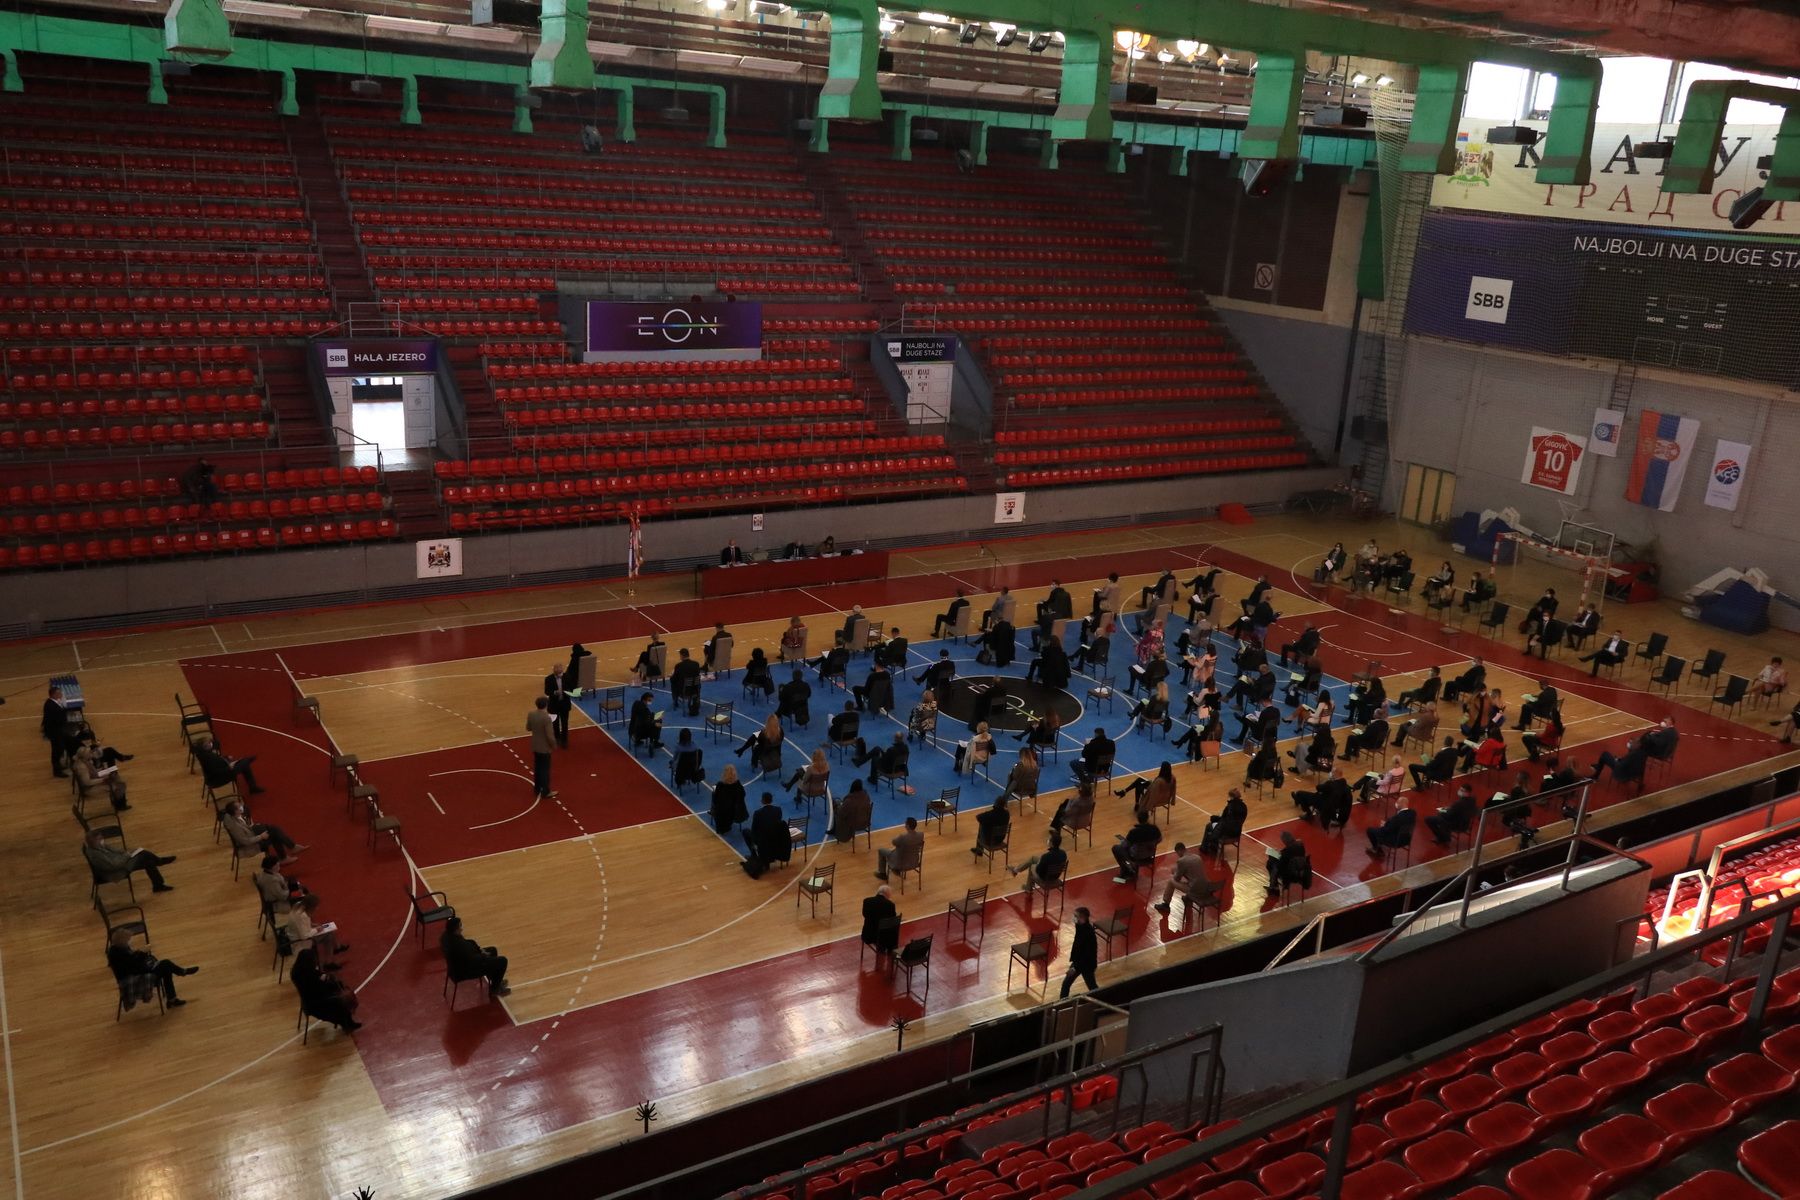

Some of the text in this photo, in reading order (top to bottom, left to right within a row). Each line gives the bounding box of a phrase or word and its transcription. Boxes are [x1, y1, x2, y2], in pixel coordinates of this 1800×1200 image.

[1573, 236, 1664, 258] NAJBOLJI
[1669, 243, 1697, 261] NA
[1704, 246, 1764, 266] DUGE
[1472, 292, 1505, 309] SBB
[638, 308, 717, 343] EON
[329, 354, 346, 362] SBB
[353, 353, 427, 362] HALA JEZERO
[1543, 449, 1566, 472] 10
